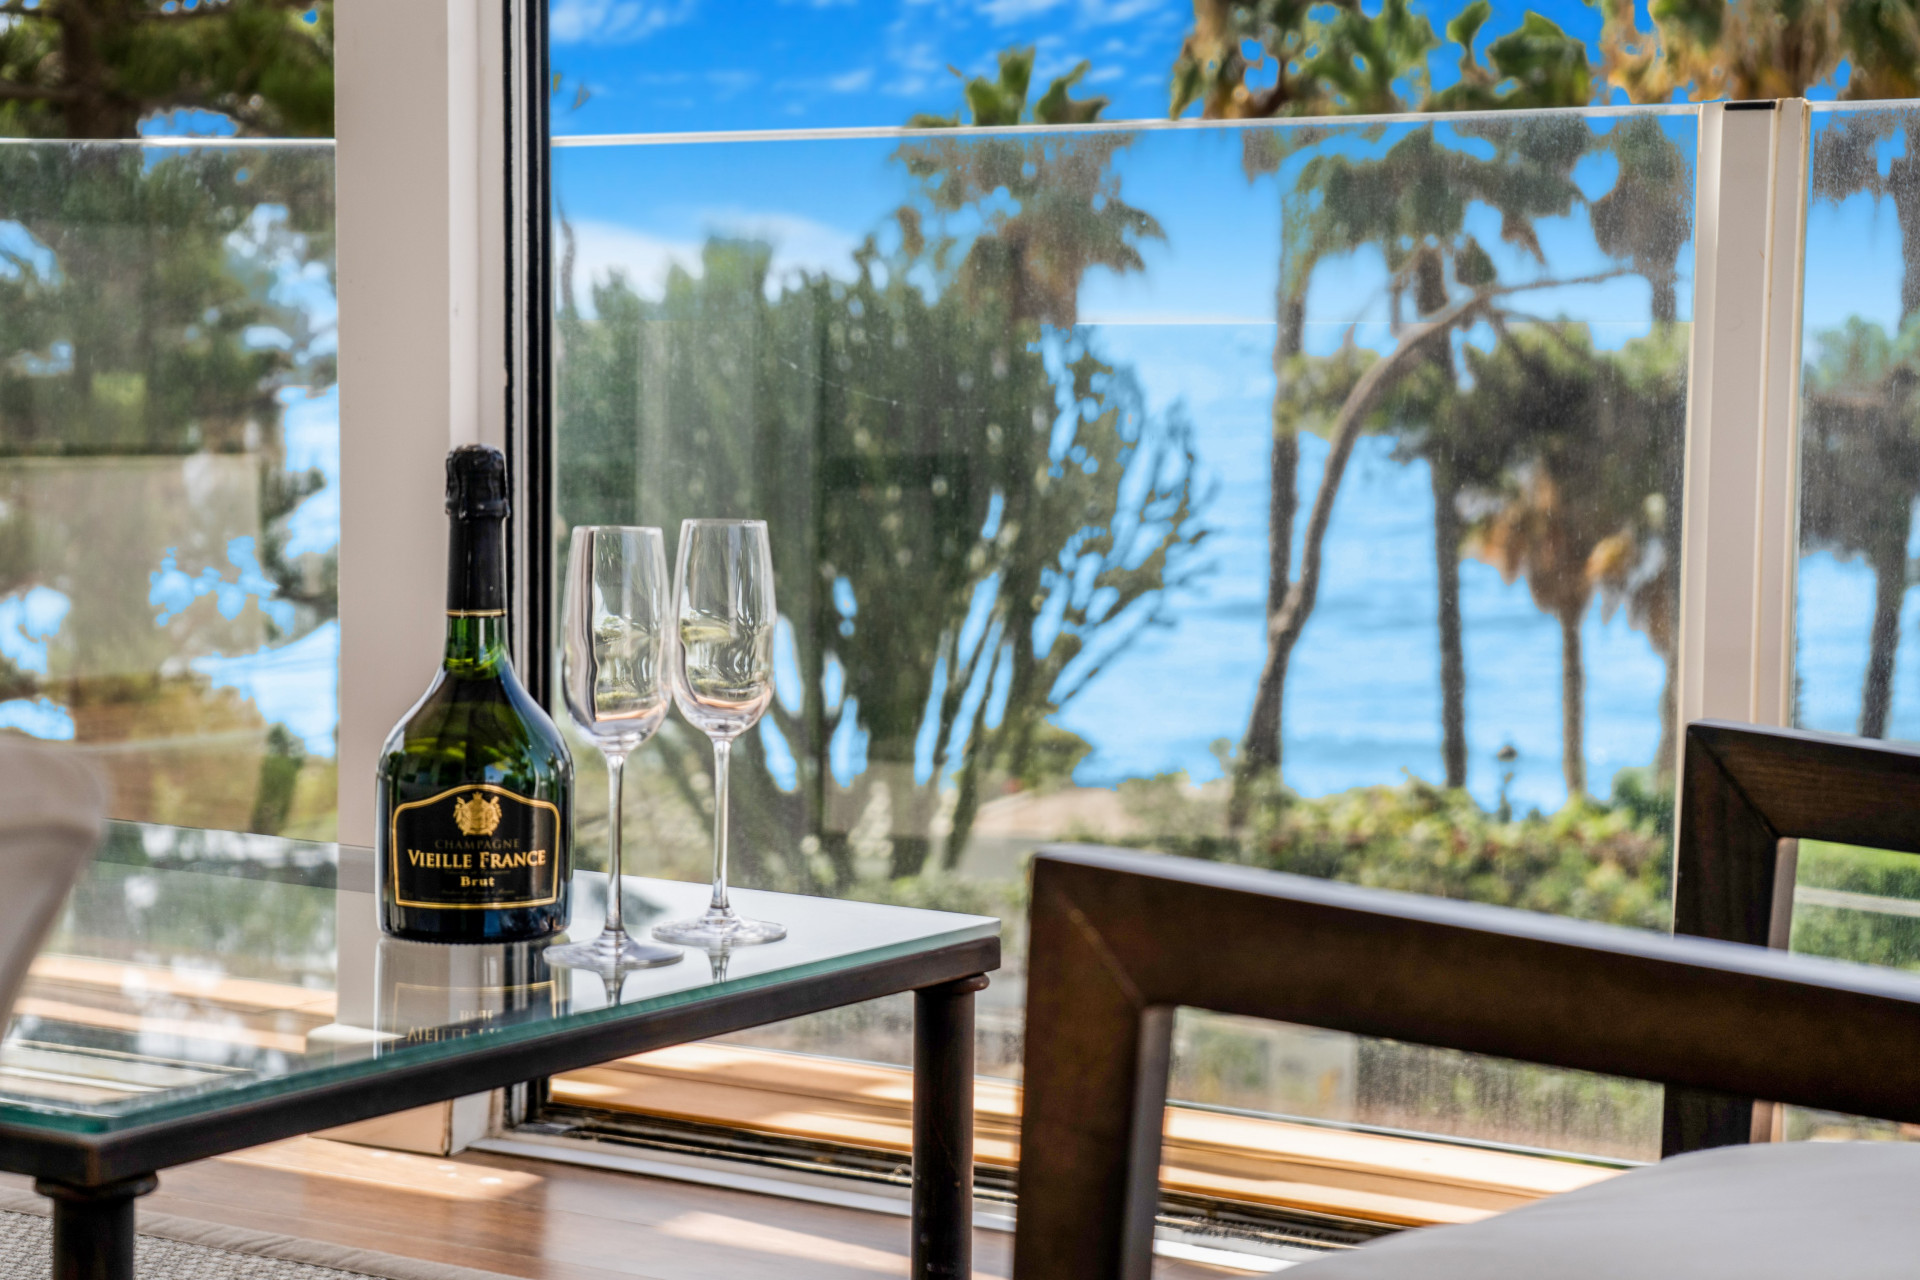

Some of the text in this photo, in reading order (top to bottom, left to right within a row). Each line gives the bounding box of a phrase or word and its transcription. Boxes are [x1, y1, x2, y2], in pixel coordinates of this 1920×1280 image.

[434, 838, 520, 849] CHAMPAGNE
[407, 849, 547, 869] VIEILLE FRANCE
[460, 876, 495, 887] Brut
